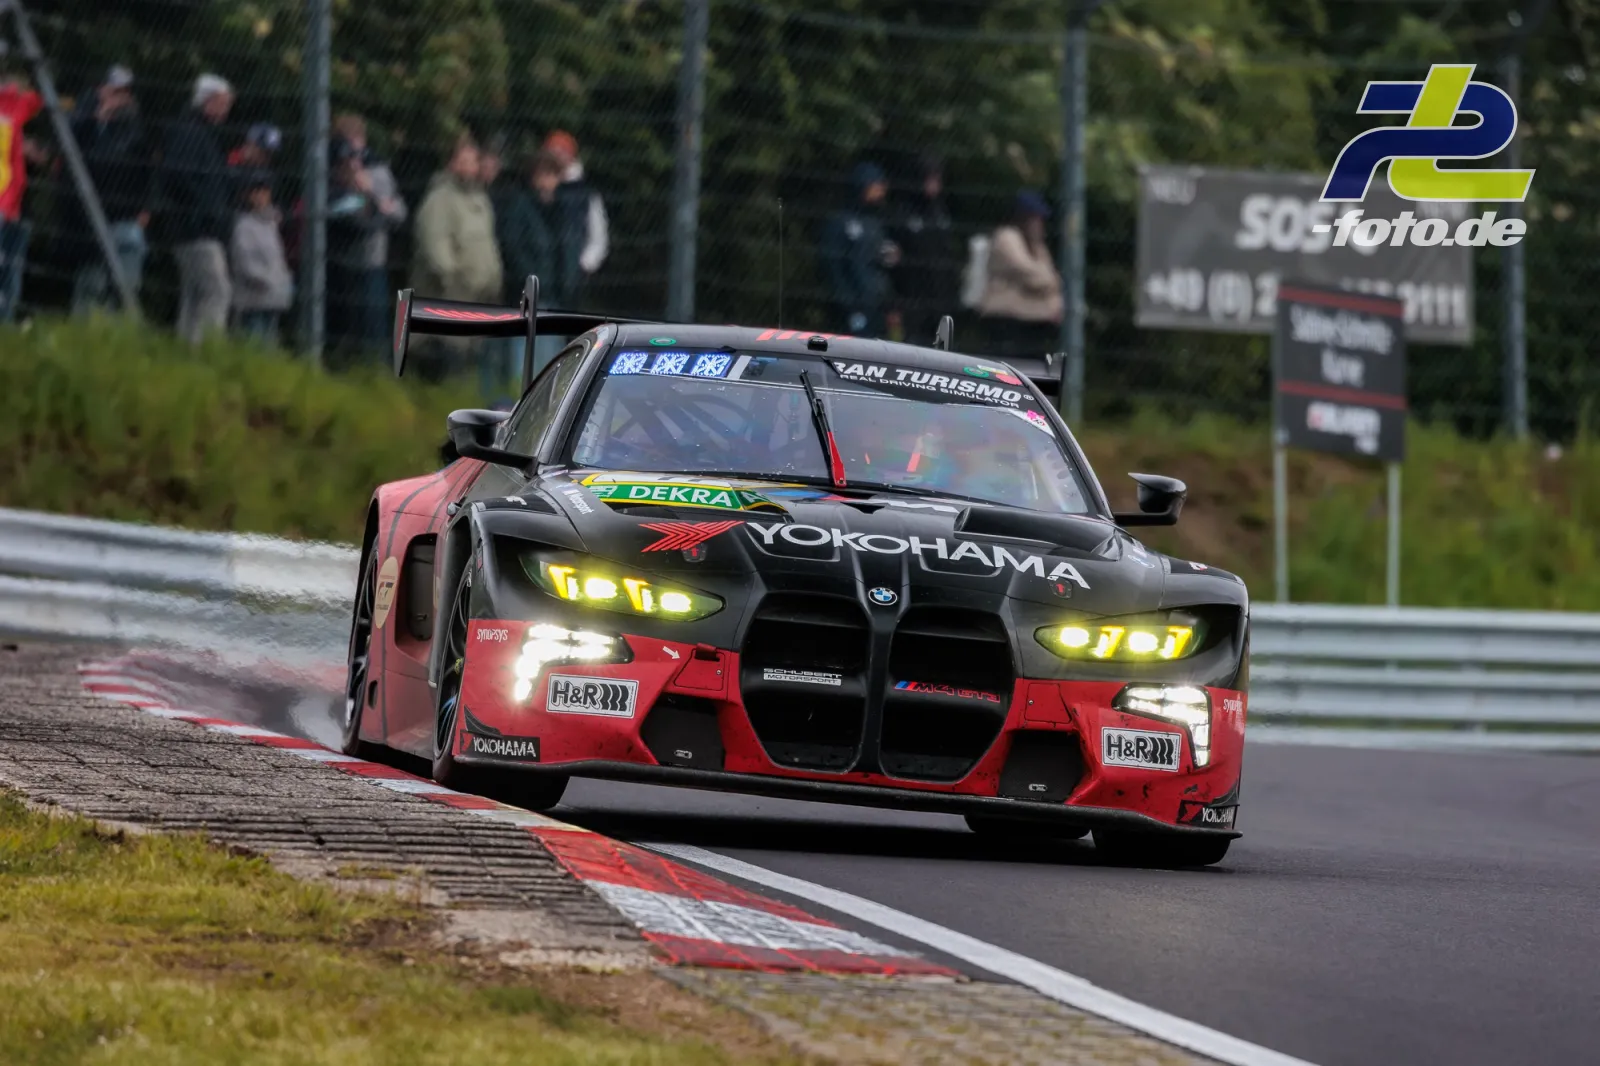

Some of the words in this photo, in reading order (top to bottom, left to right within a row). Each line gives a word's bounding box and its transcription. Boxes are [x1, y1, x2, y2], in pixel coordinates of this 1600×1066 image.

[833, 361, 887, 378] RAN
[895, 368, 1021, 403] TURISMO
[840, 374, 877, 383] REAL
[880, 378, 937, 392] DRIVING
[940, 387, 1020, 409] SIMULATOR
[629, 485, 733, 508] DEKRA
[747, 522, 1091, 590] YOKOHAMA
[763, 667, 842, 679] SCHUBERT
[767, 674, 838, 685] MOTORSPORT
[552, 679, 601, 710] H&R
[473, 736, 537, 758] YOKOHAMA
[1106, 733, 1151, 763] H&R
